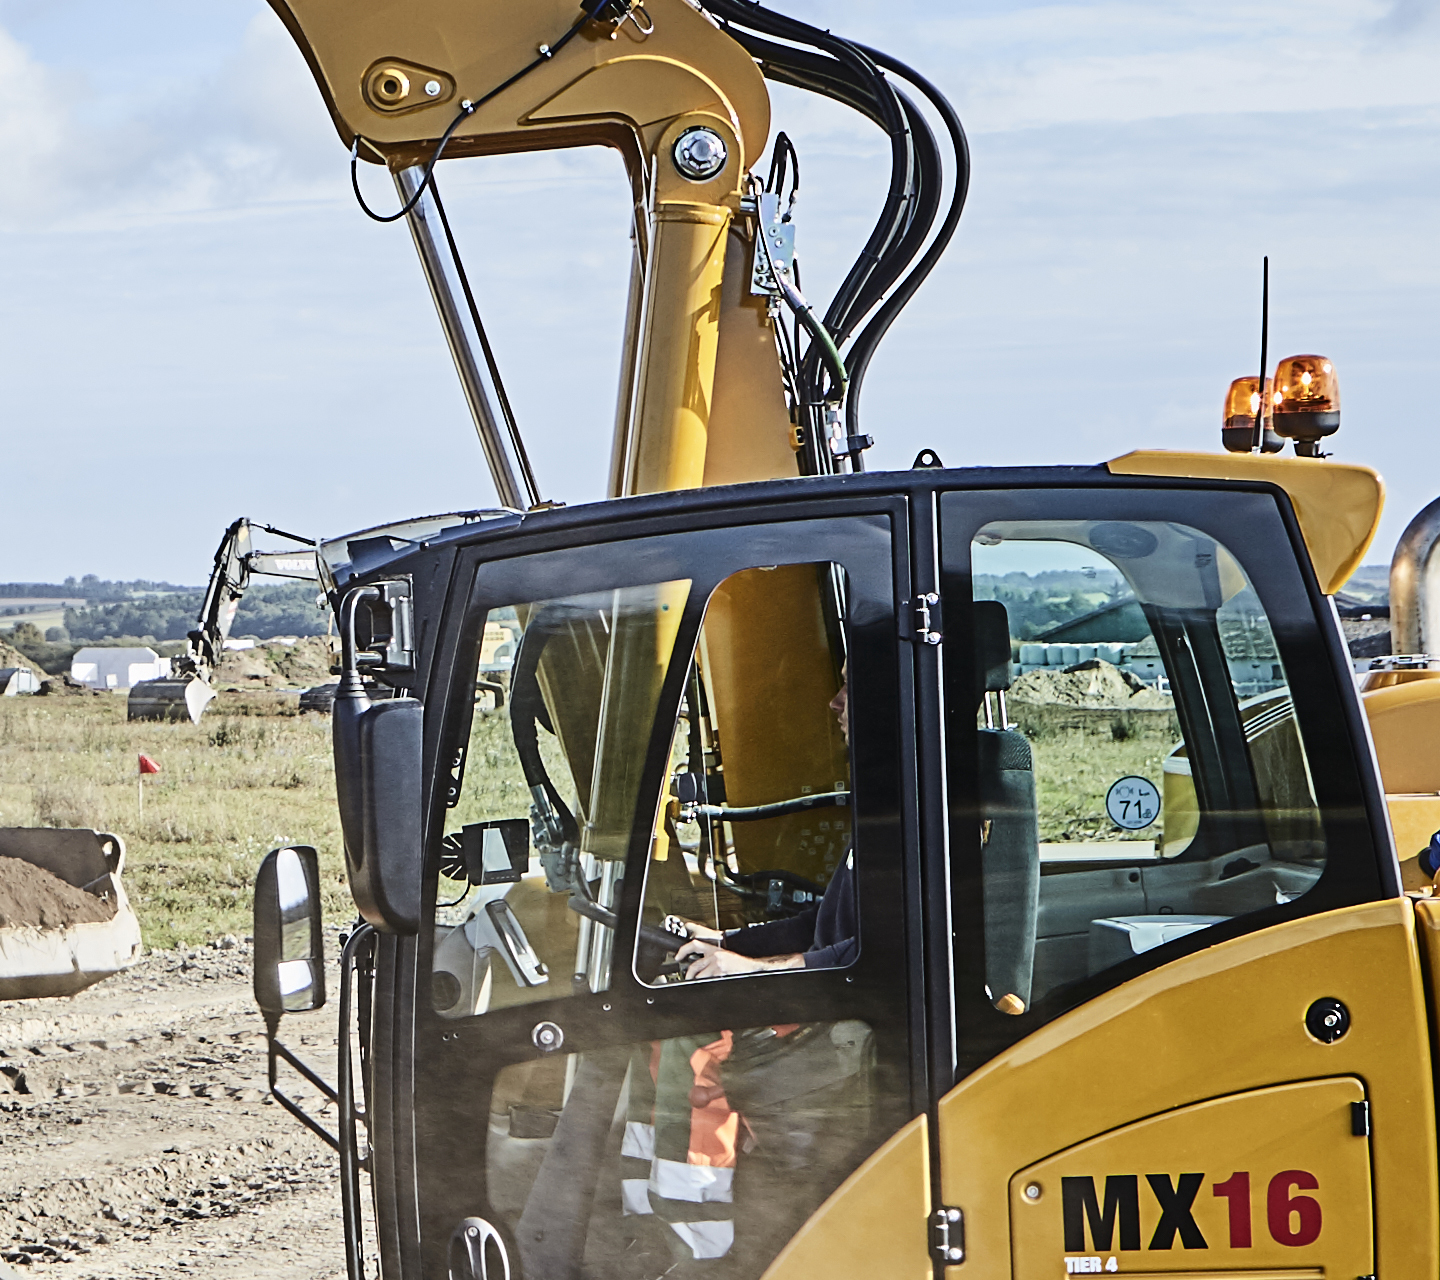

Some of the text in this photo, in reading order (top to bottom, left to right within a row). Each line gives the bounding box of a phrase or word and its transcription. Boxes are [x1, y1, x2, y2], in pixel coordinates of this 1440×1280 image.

[1119, 800, 1141, 819] 71
[1061, 1170, 1323, 1252] MX16
[1064, 1256, 1118, 1273] TIER 4
